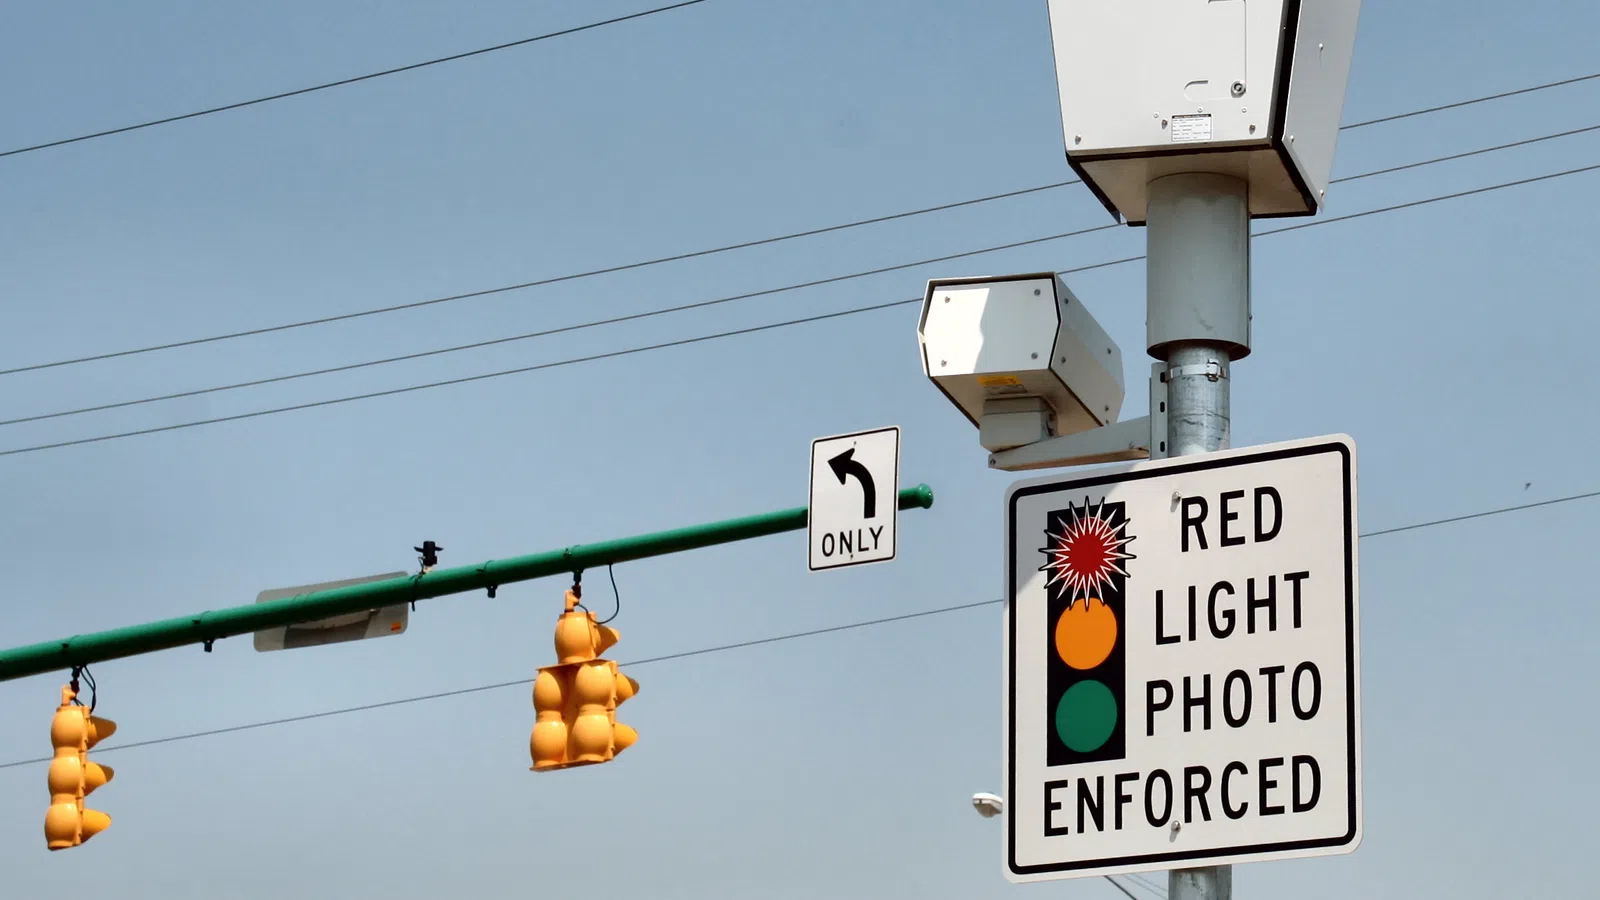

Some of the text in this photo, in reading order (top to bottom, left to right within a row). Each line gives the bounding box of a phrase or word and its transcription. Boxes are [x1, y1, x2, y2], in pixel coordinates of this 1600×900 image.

[821, 525, 884, 558] ONLY
[1181, 486, 1283, 553] RED
[1155, 570, 1310, 646] LIGHT
[1146, 660, 1322, 737] PHOTO
[1043, 754, 1322, 838] ENFORCED
